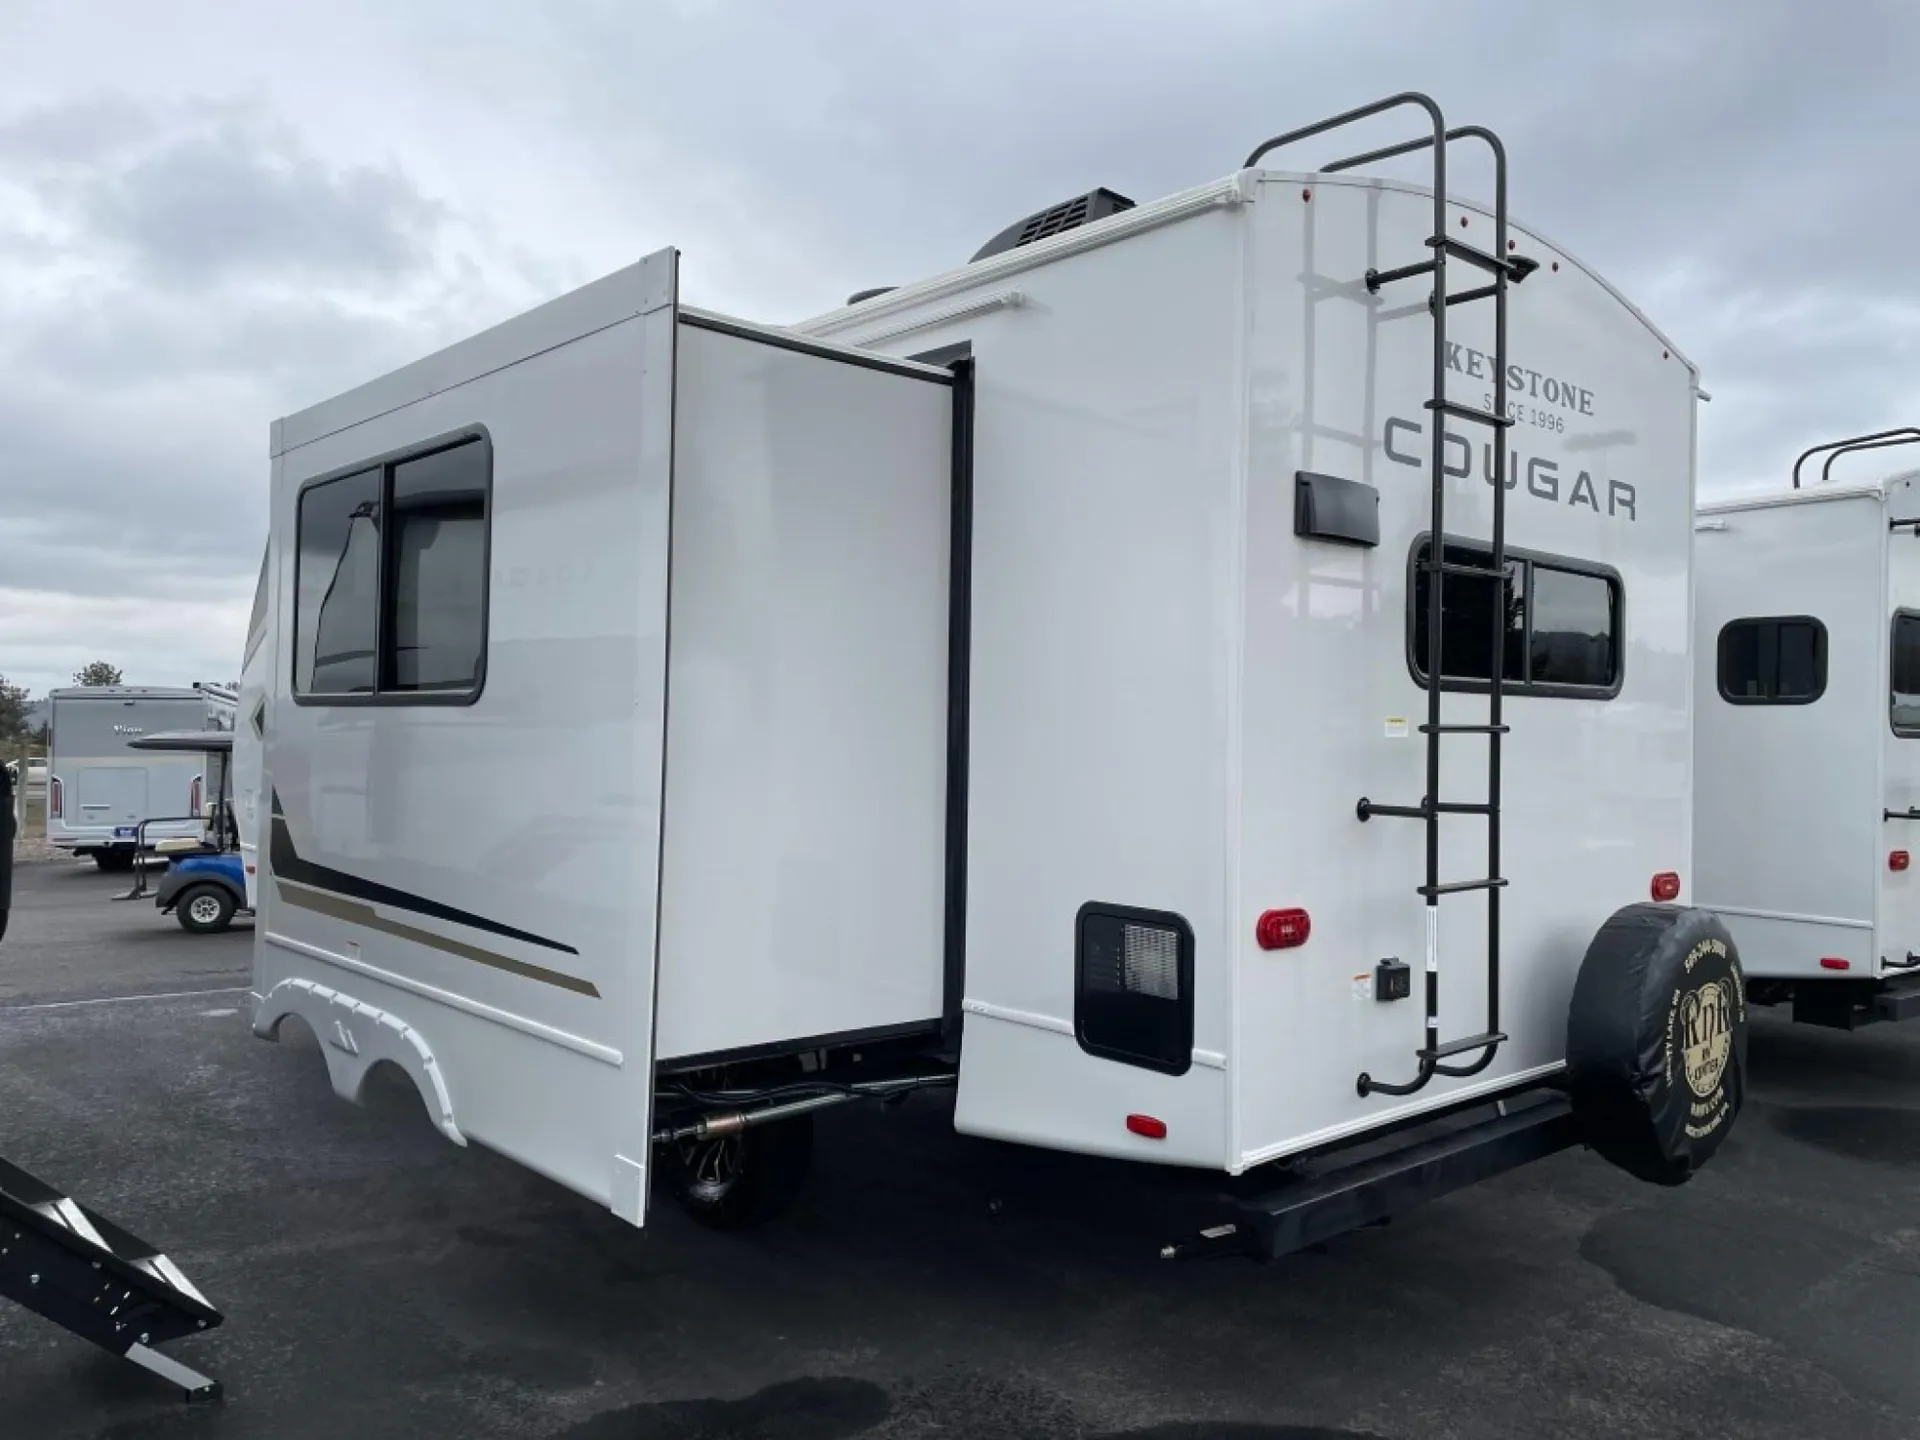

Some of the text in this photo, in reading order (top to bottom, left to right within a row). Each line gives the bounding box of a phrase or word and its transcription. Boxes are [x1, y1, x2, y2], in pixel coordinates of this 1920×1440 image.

[1483, 393, 1565, 434] SCE 1996
[1384, 416, 1636, 521] COUGAR
